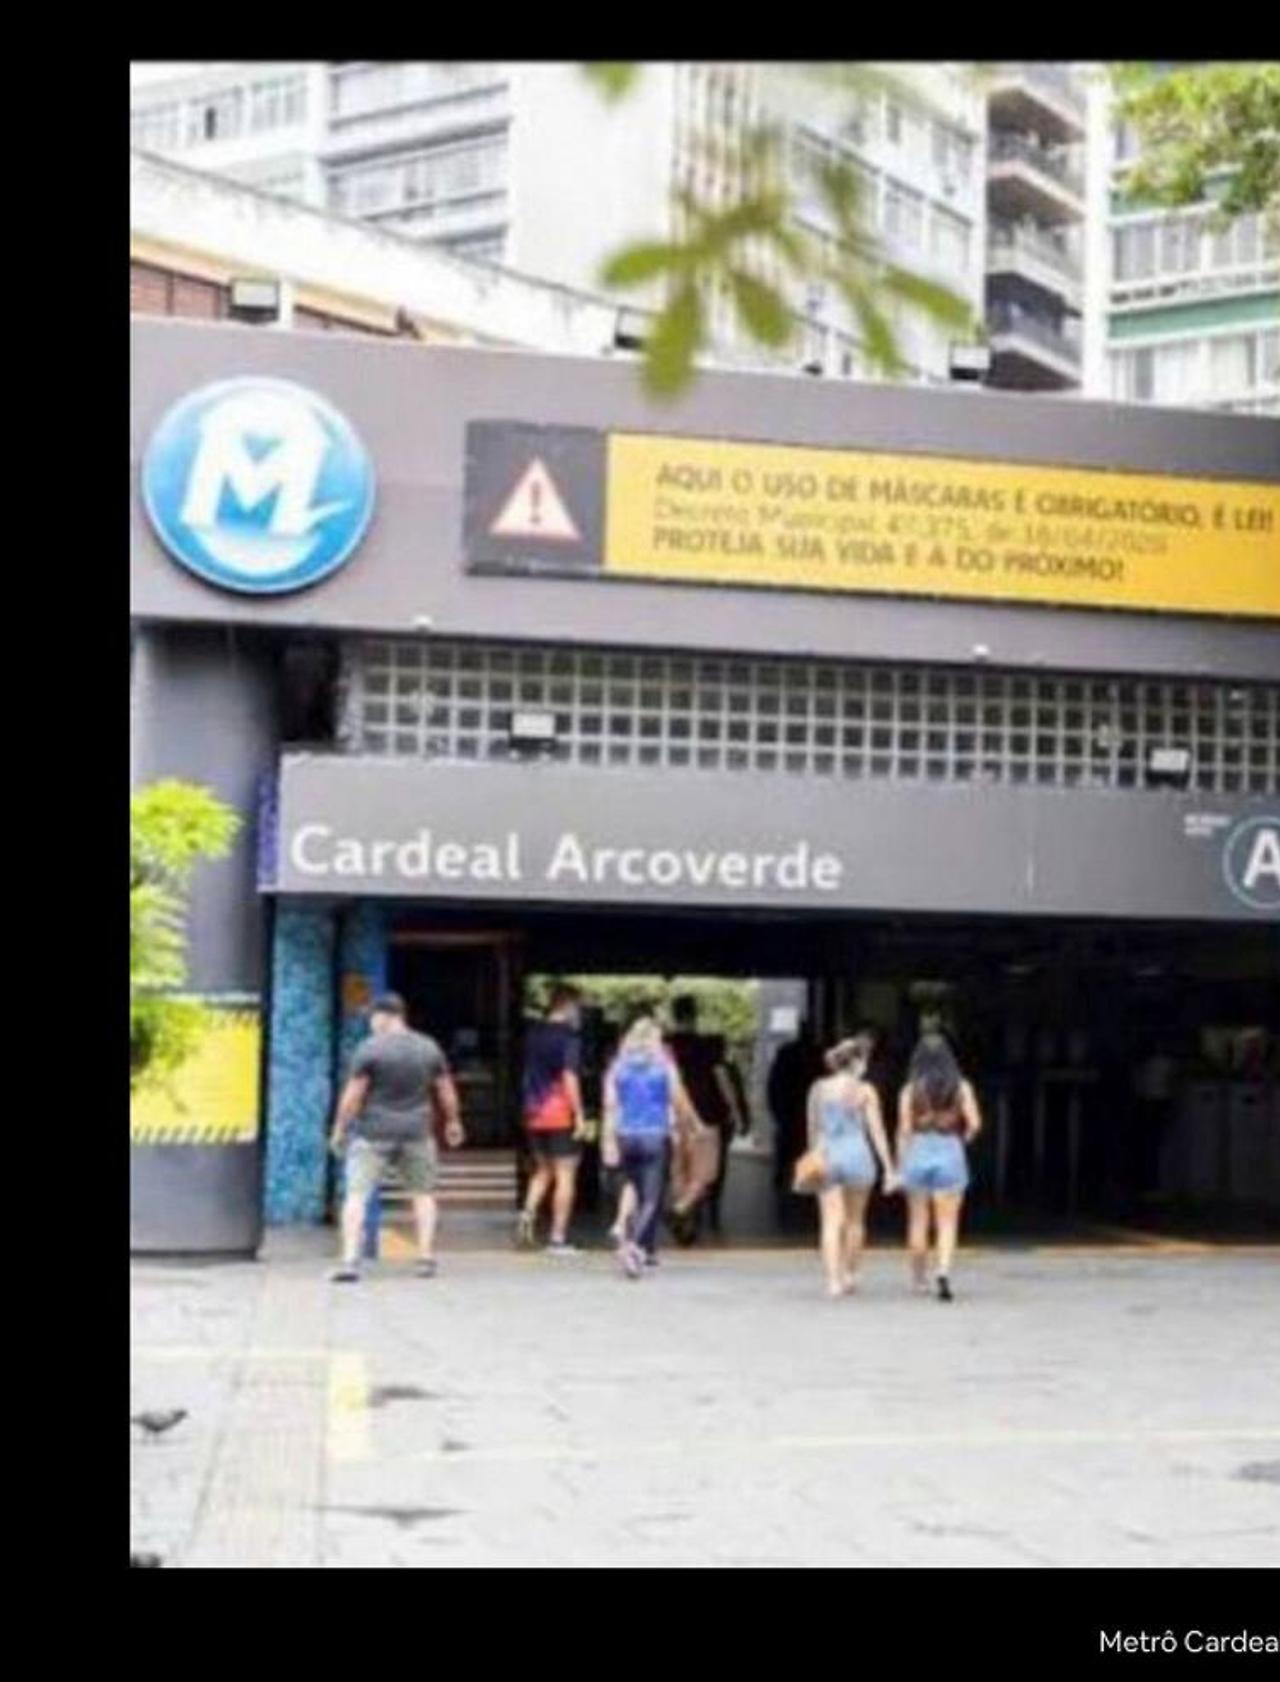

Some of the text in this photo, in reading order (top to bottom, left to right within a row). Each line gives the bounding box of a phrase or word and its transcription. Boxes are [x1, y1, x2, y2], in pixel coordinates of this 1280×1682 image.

[656, 462, 722, 491] AQUI
[731, 467, 753, 494] O
[762, 470, 817, 499] USO
[826, 474, 857, 502] DE
[652, 525, 764, 556] PROTEJA
[775, 532, 827, 561] SUA
[838, 537, 896, 565] VIDA
[928, 542, 947, 568] A
[957, 544, 993, 572] DO
[290, 824, 844, 890] Cardeal Arcoverde
